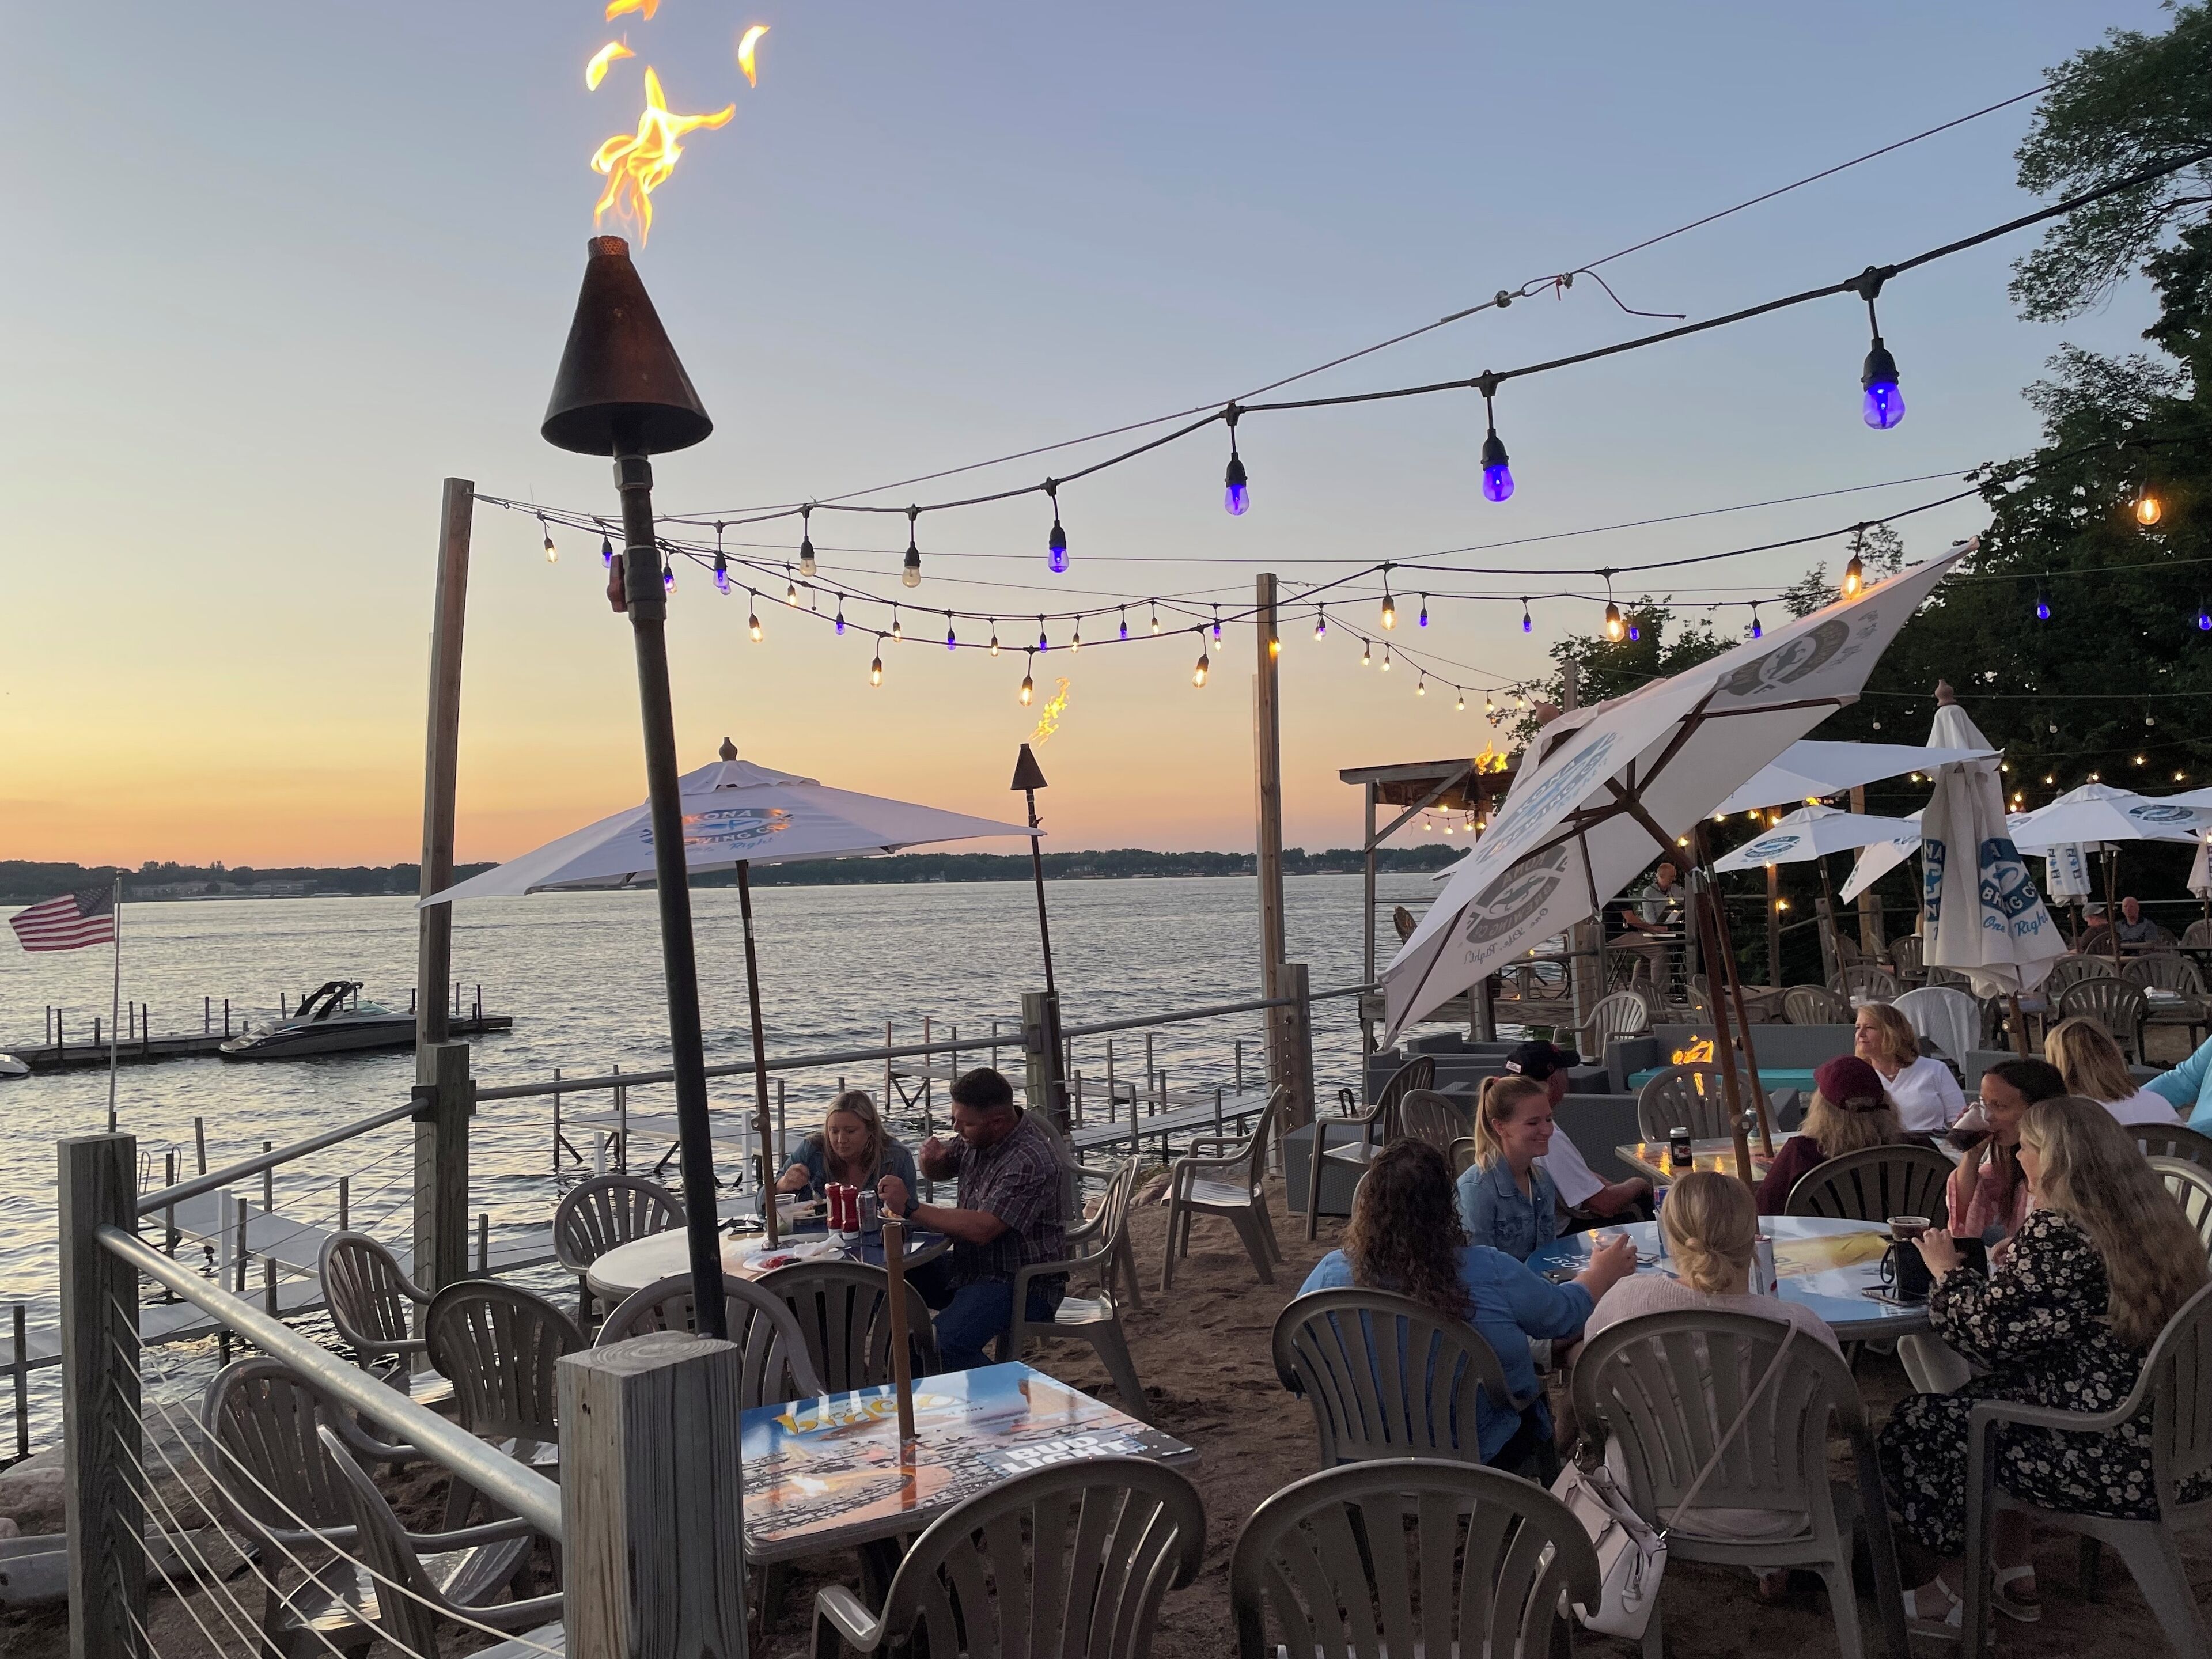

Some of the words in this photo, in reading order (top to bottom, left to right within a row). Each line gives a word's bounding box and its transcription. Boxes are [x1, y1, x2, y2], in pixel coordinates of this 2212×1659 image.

[1516, 760, 1576, 815] KONA
[689, 810, 751, 822] KONA
[1983, 915, 2006, 933] One
[1001, 1440, 1128, 1474] LIGHT
[1005, 1437, 1099, 1461] BUD
